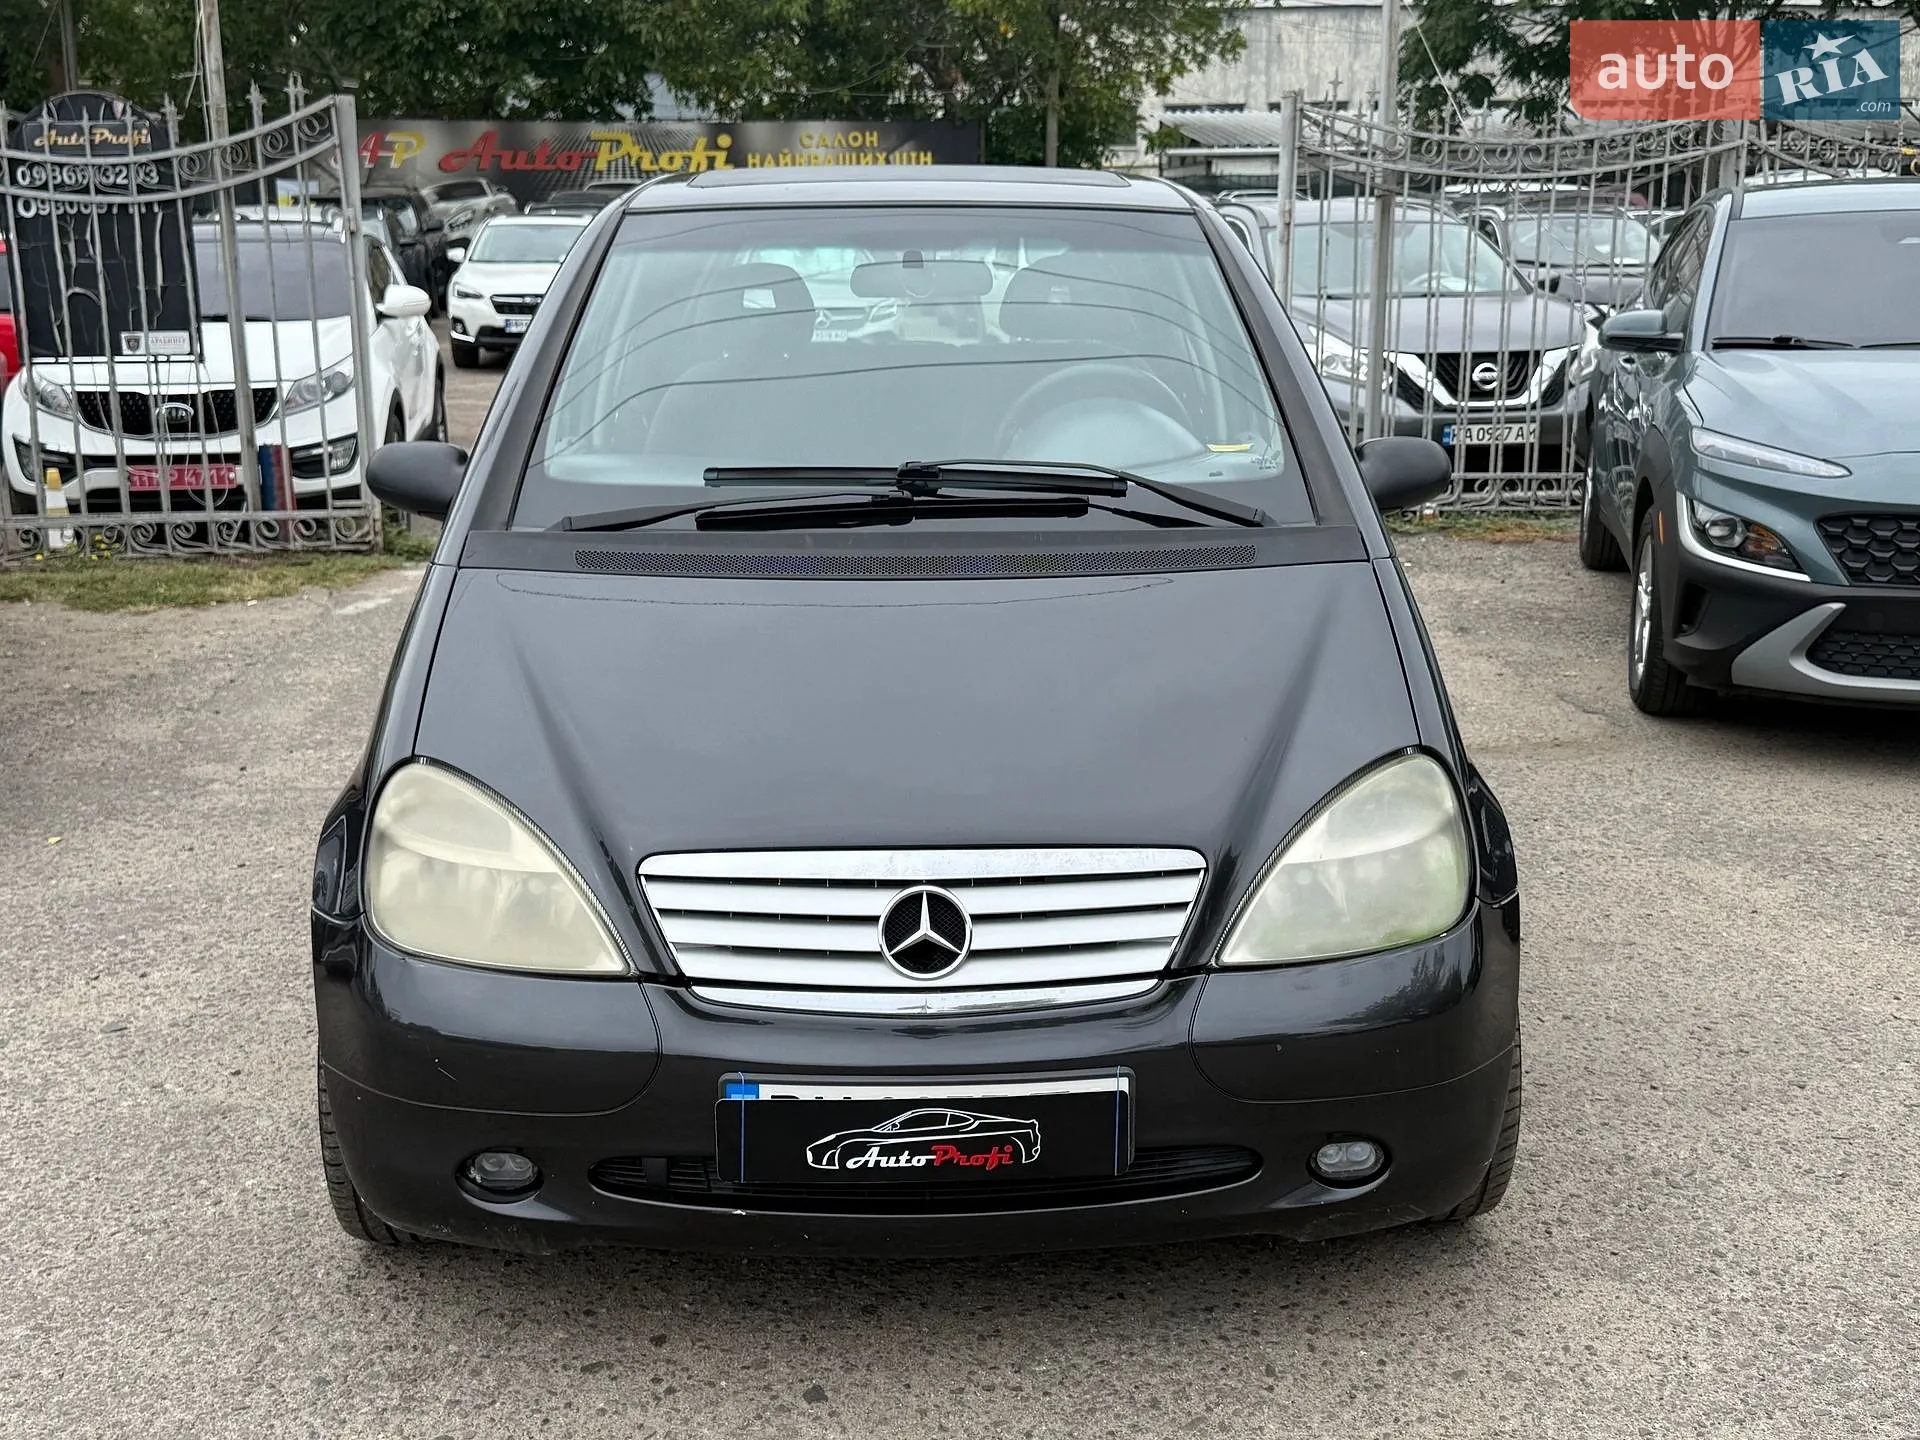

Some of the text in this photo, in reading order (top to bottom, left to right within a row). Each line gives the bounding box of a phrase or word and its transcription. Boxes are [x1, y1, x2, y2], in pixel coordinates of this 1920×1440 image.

[437, 130, 735, 174] AutoProfi
[800, 130, 879, 149] САЛОН
[846, 1144, 1014, 1170] AutoProfi
